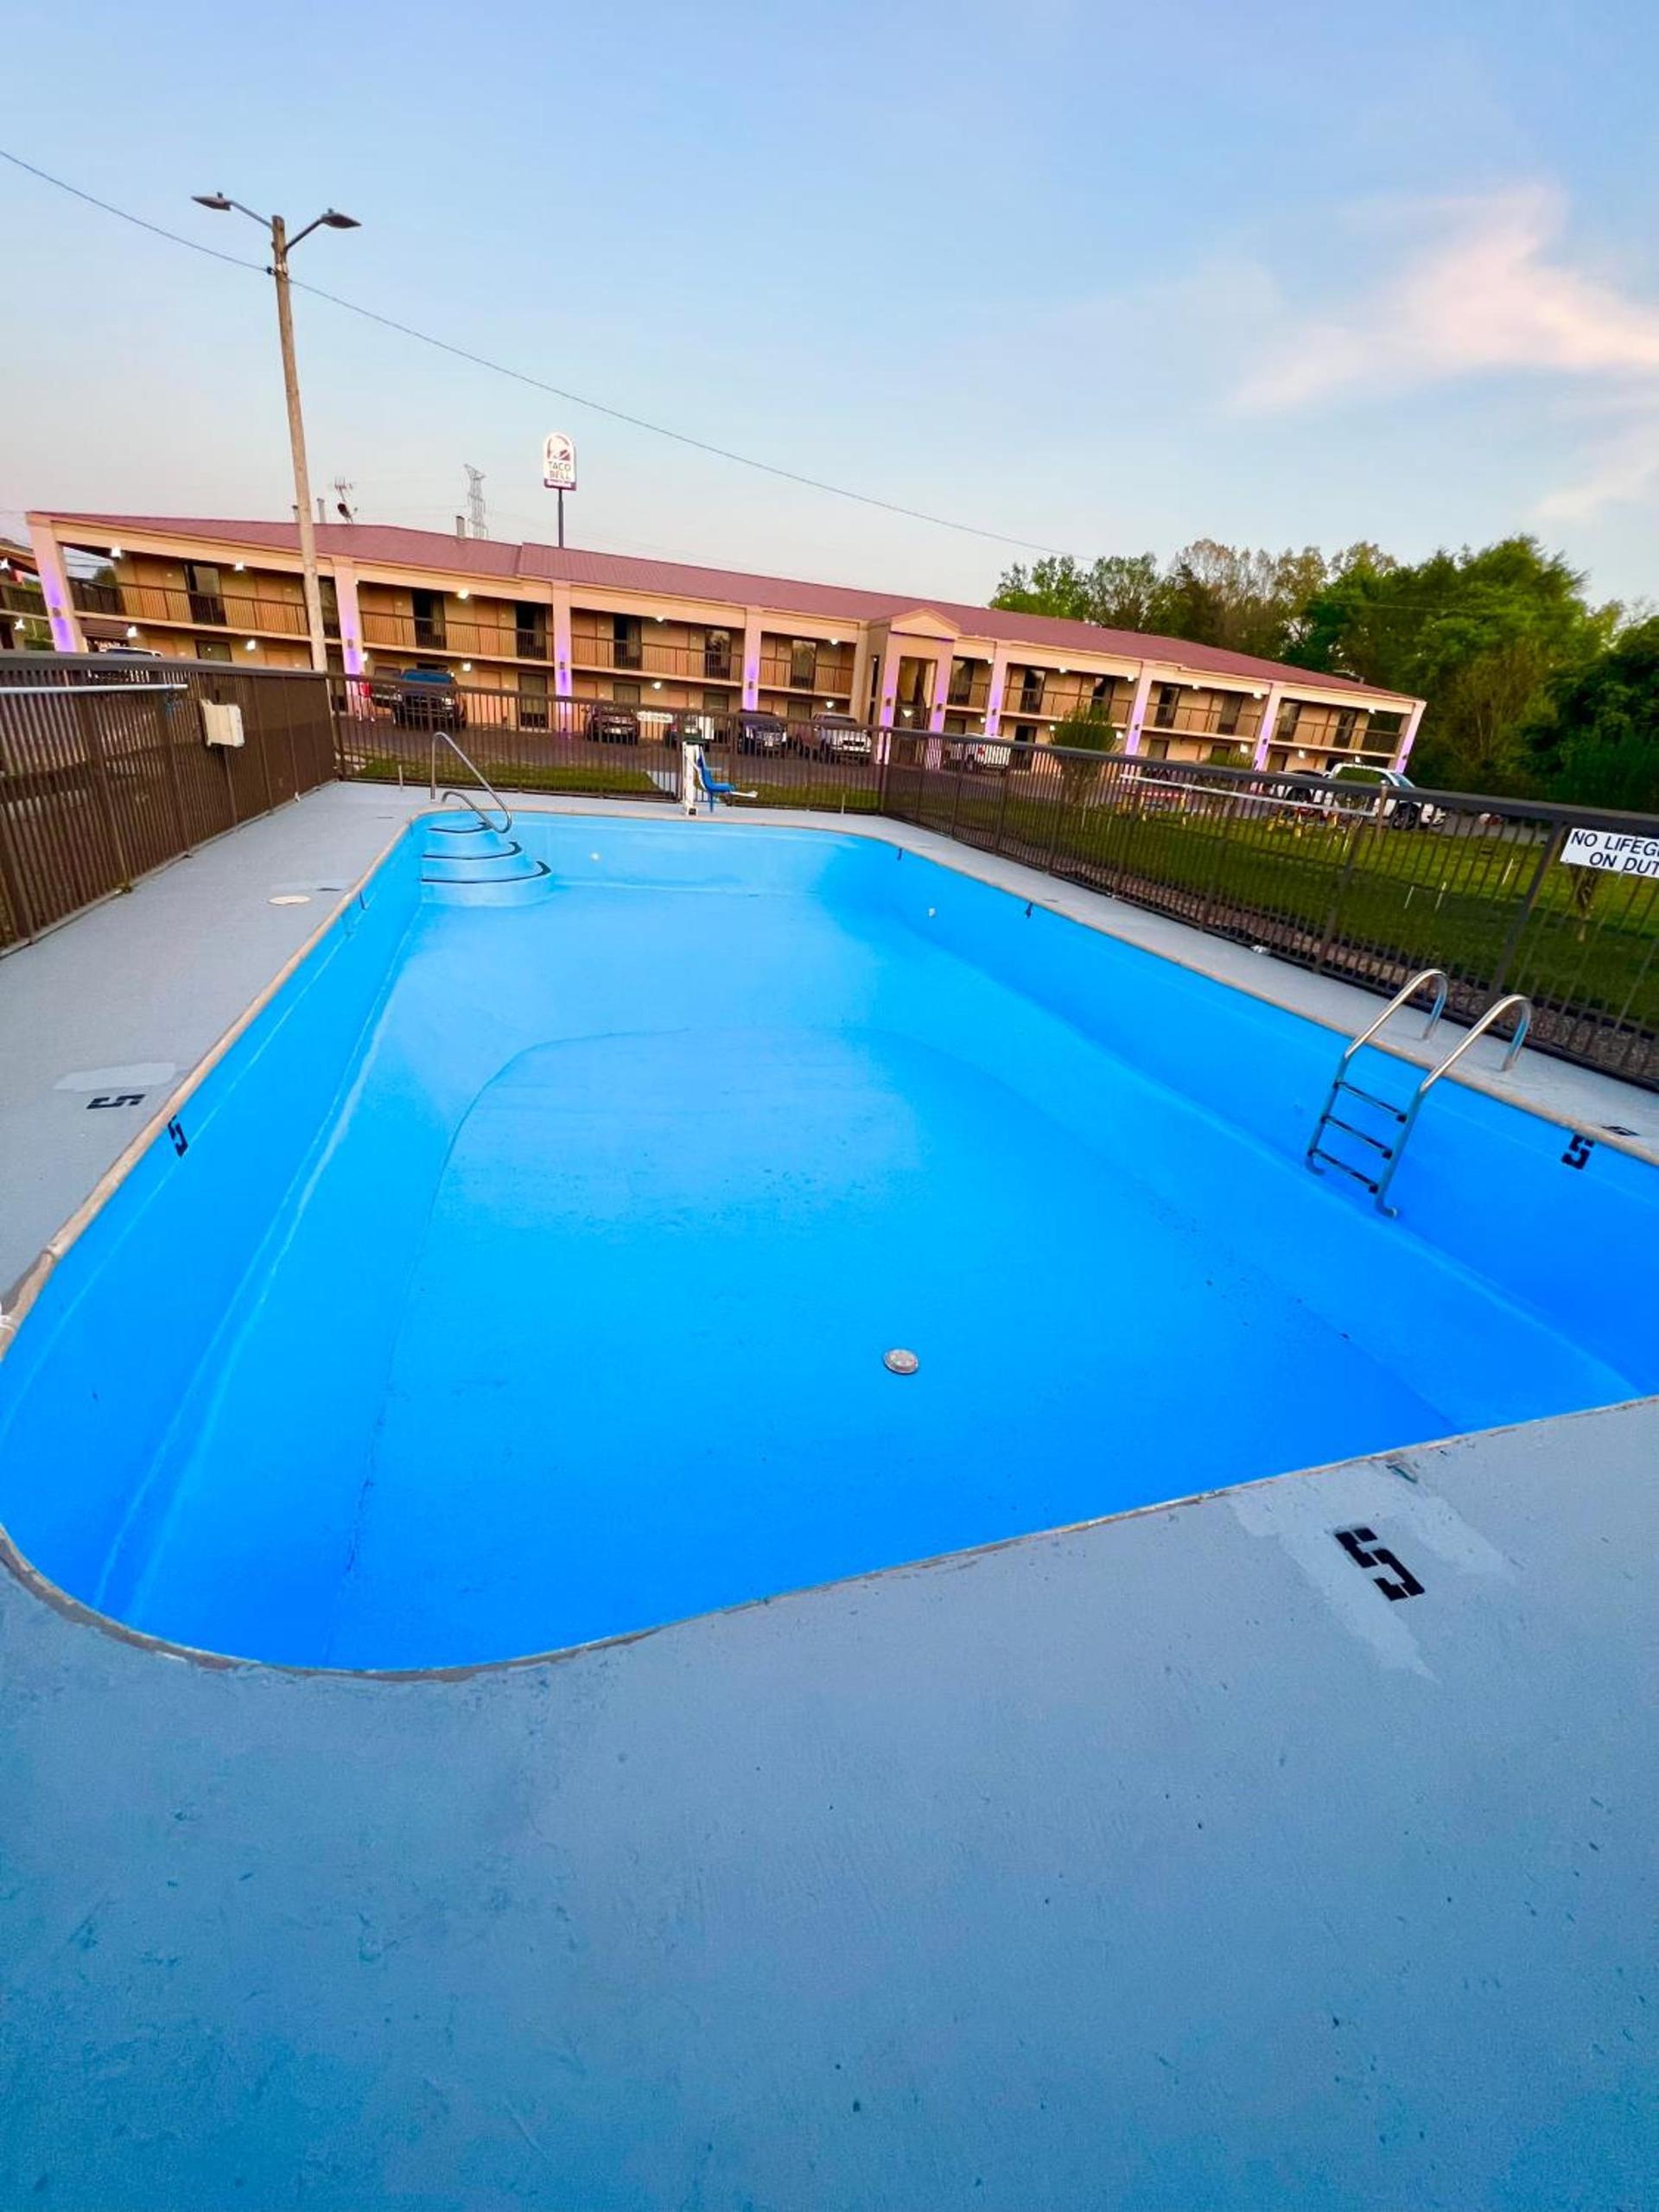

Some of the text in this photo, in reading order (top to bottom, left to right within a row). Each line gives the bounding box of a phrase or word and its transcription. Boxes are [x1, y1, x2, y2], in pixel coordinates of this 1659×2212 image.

[548, 461, 571, 472] TACO
[1571, 830, 1659, 857] NO LIFEG
[1590, 852, 1617, 868] ON
[168, 1115, 188, 1157] 5
[1561, 1134, 1595, 1170] 5
[1333, 1527, 1425, 1601] 5
